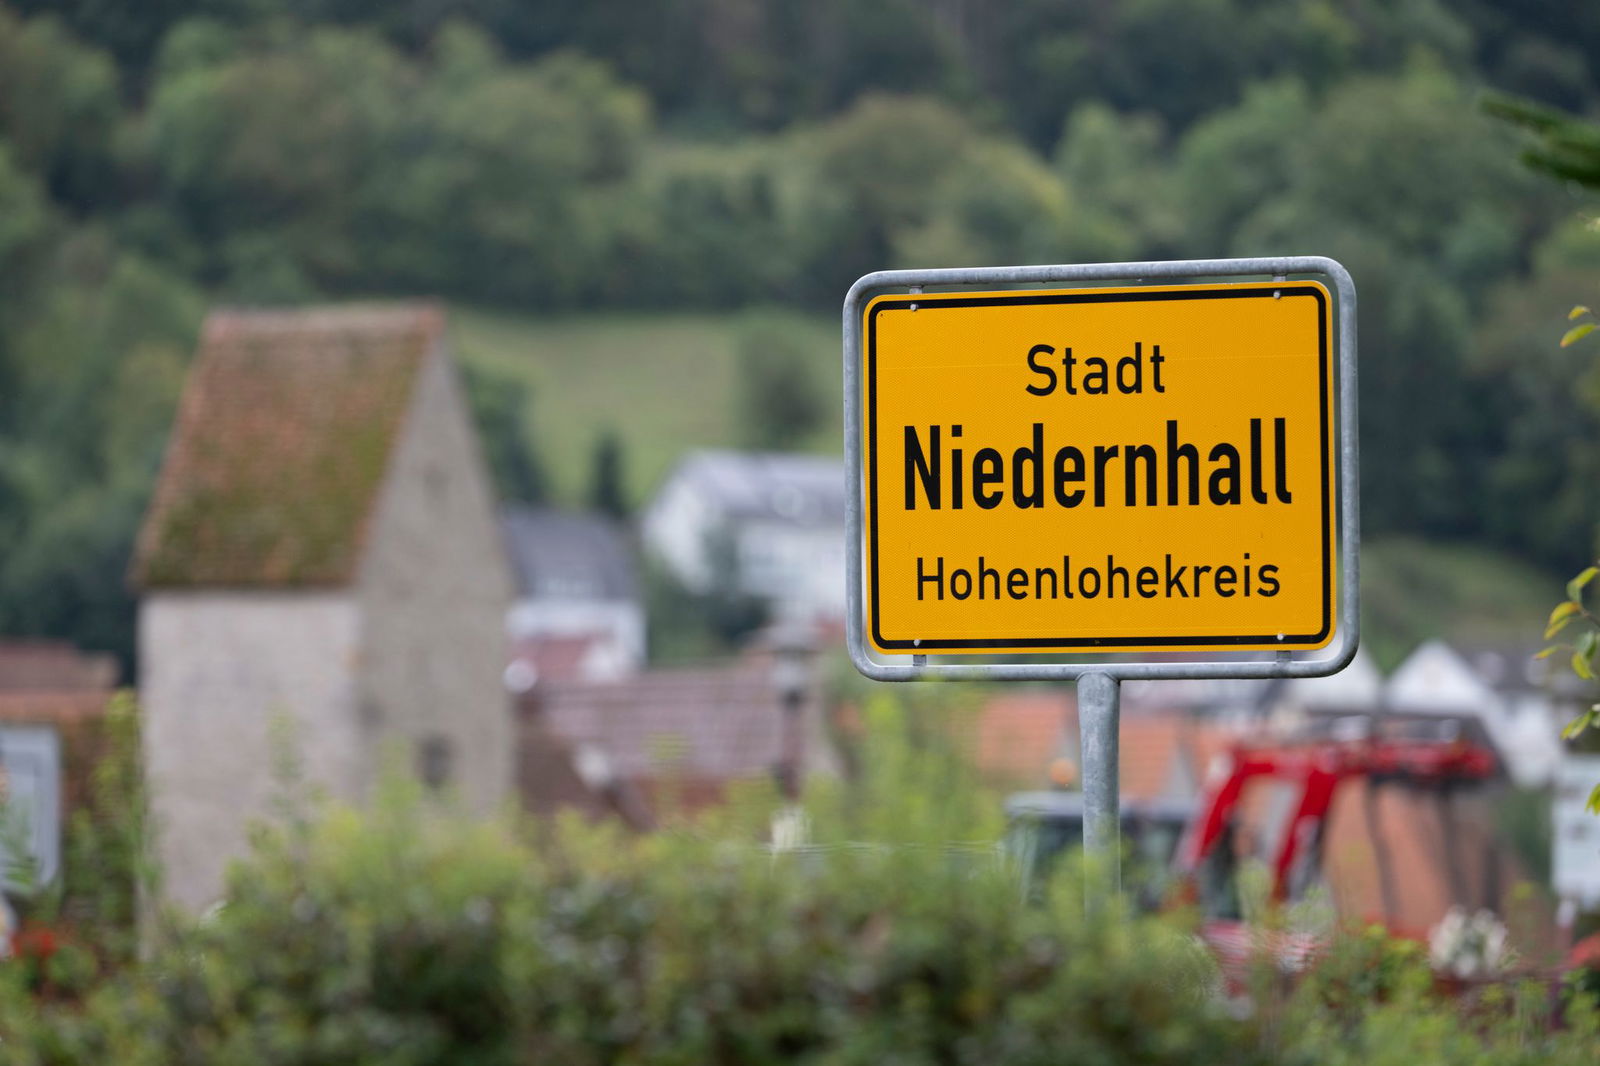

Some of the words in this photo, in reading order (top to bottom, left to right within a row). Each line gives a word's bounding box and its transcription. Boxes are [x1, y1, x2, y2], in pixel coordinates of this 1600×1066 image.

[1025, 341, 1166, 397] Stadt
[904, 417, 1293, 511] Niedernhall
[917, 552, 1281, 601] Hohenlohekreis
